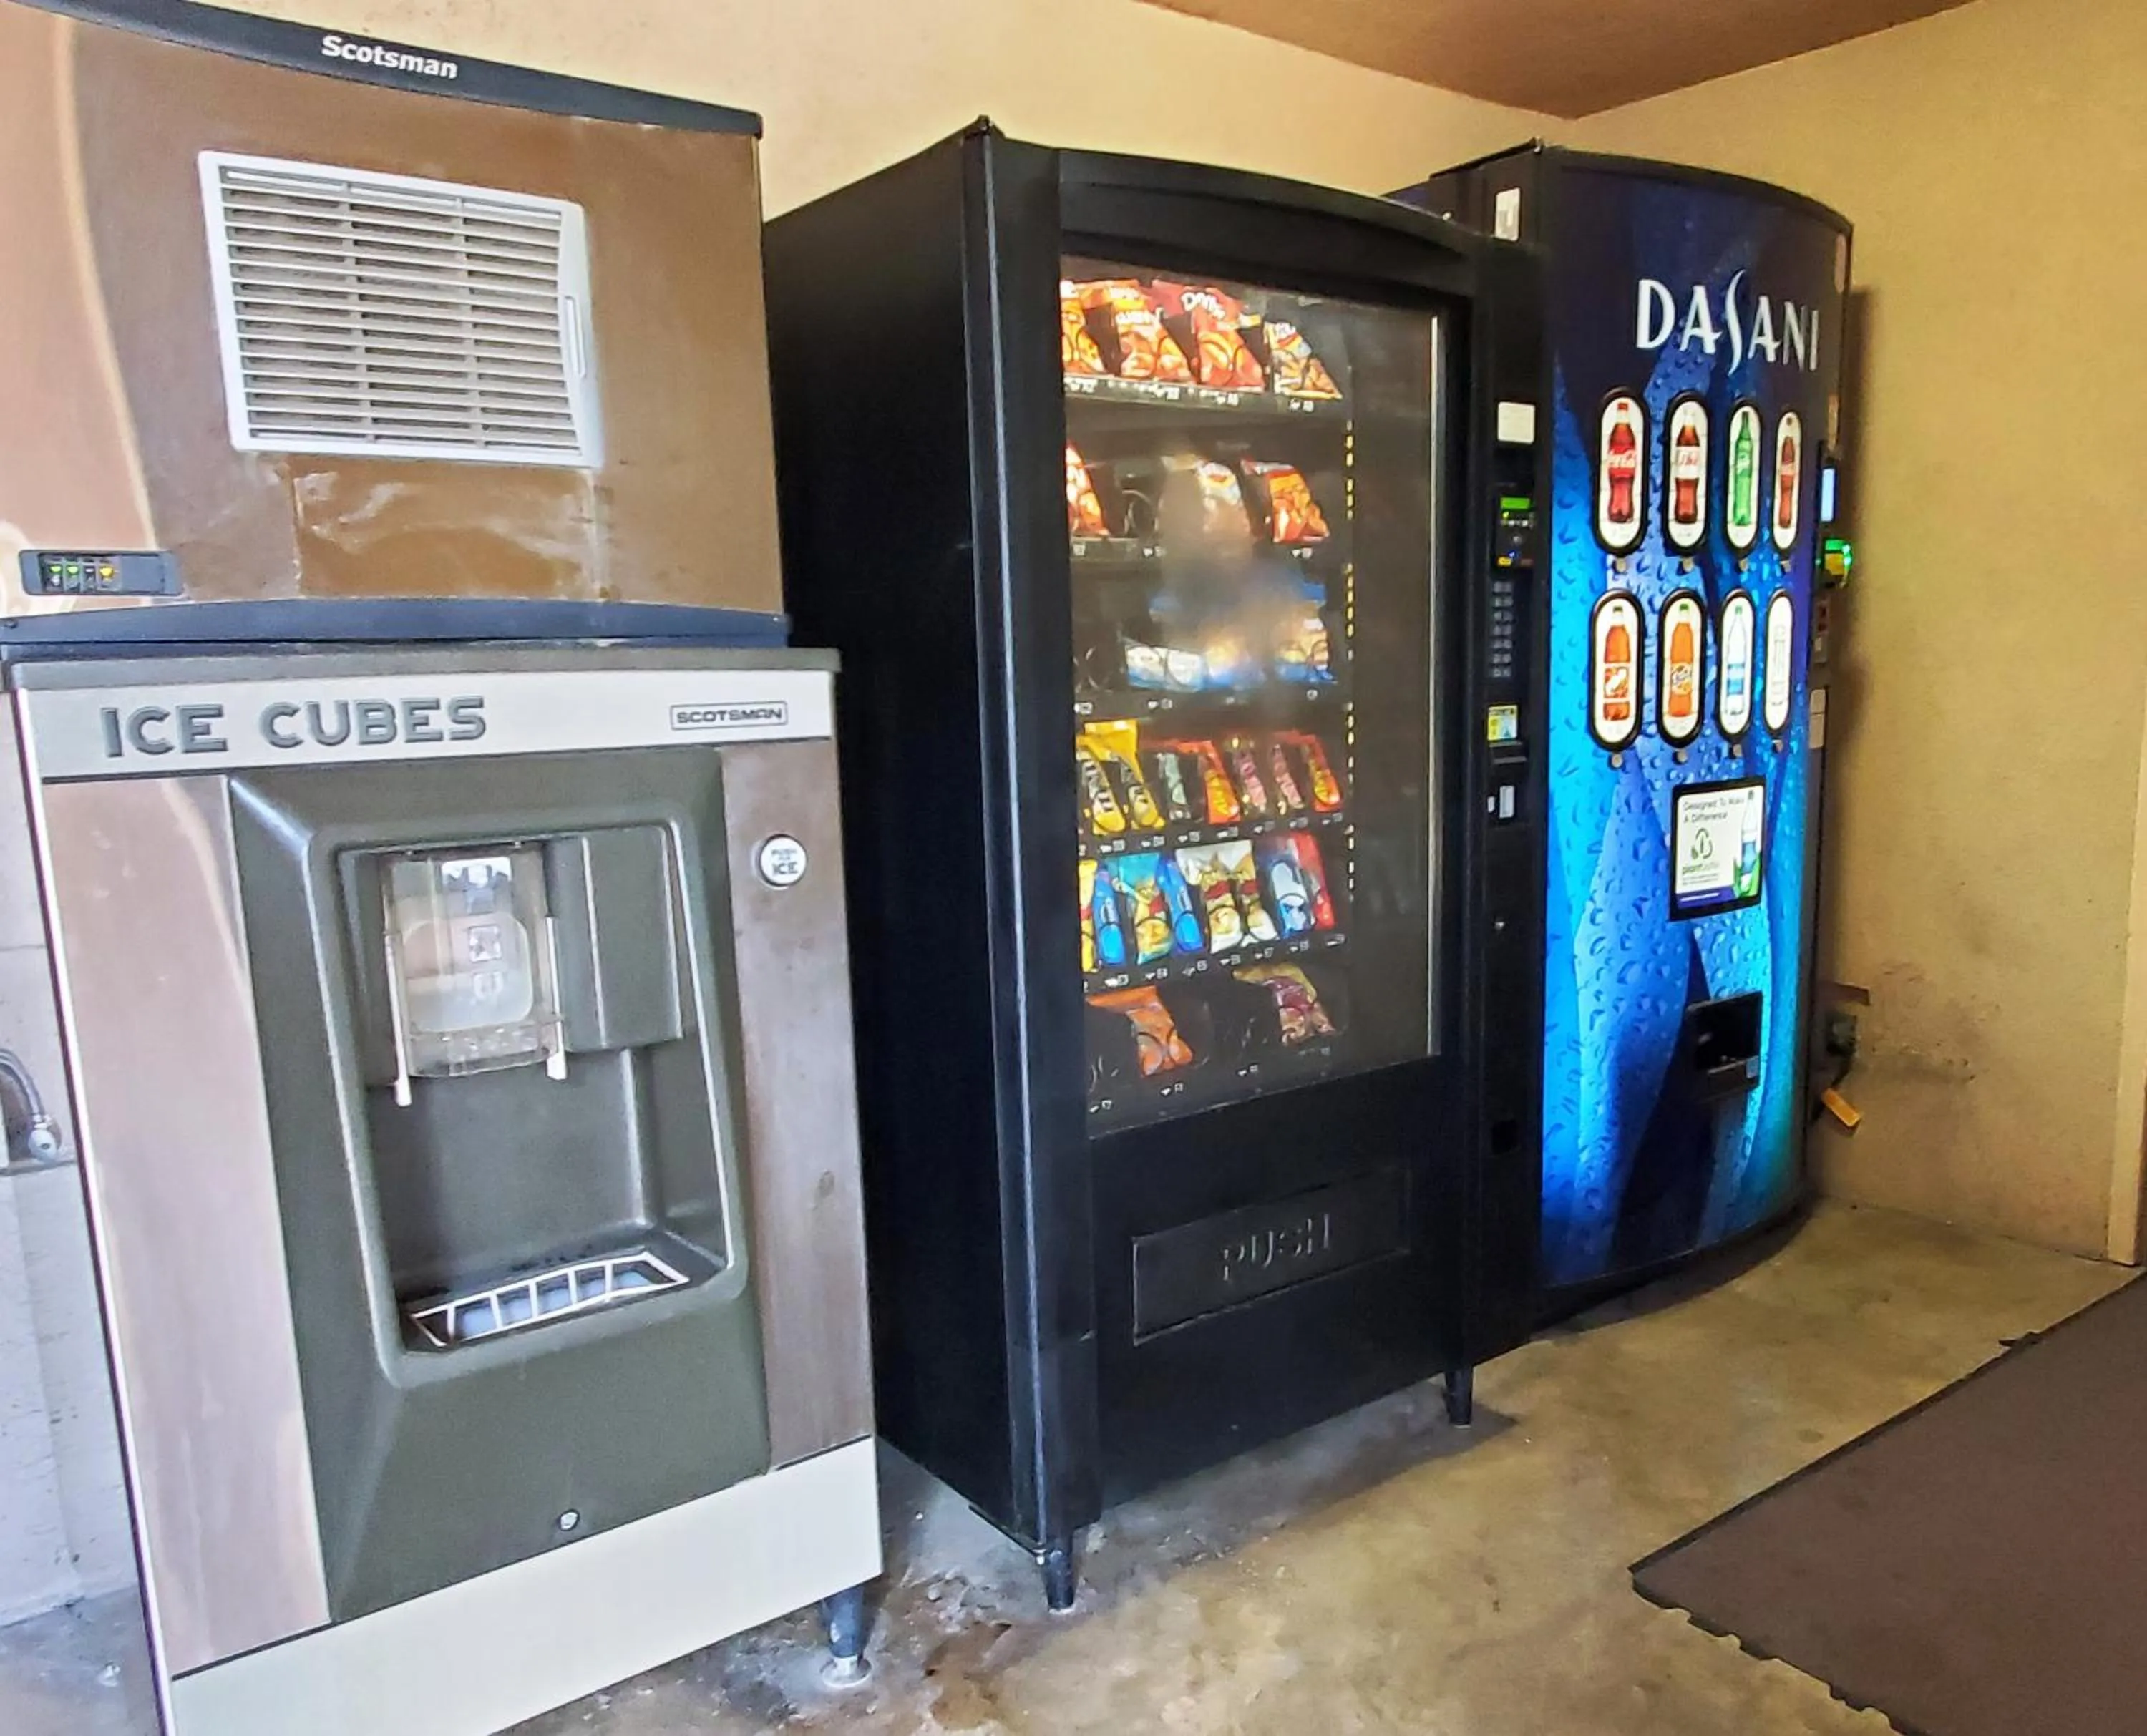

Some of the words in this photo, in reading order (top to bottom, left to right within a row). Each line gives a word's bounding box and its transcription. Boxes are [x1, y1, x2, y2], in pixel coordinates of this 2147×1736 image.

[321, 35, 458, 79] Scotsman
[1636, 268, 1817, 376] DASANI
[102, 704, 228, 757] ICE
[258, 696, 486, 748] CUBES
[676, 708, 782, 724] SCOTSMAN
[773, 862, 799, 874] ICE
